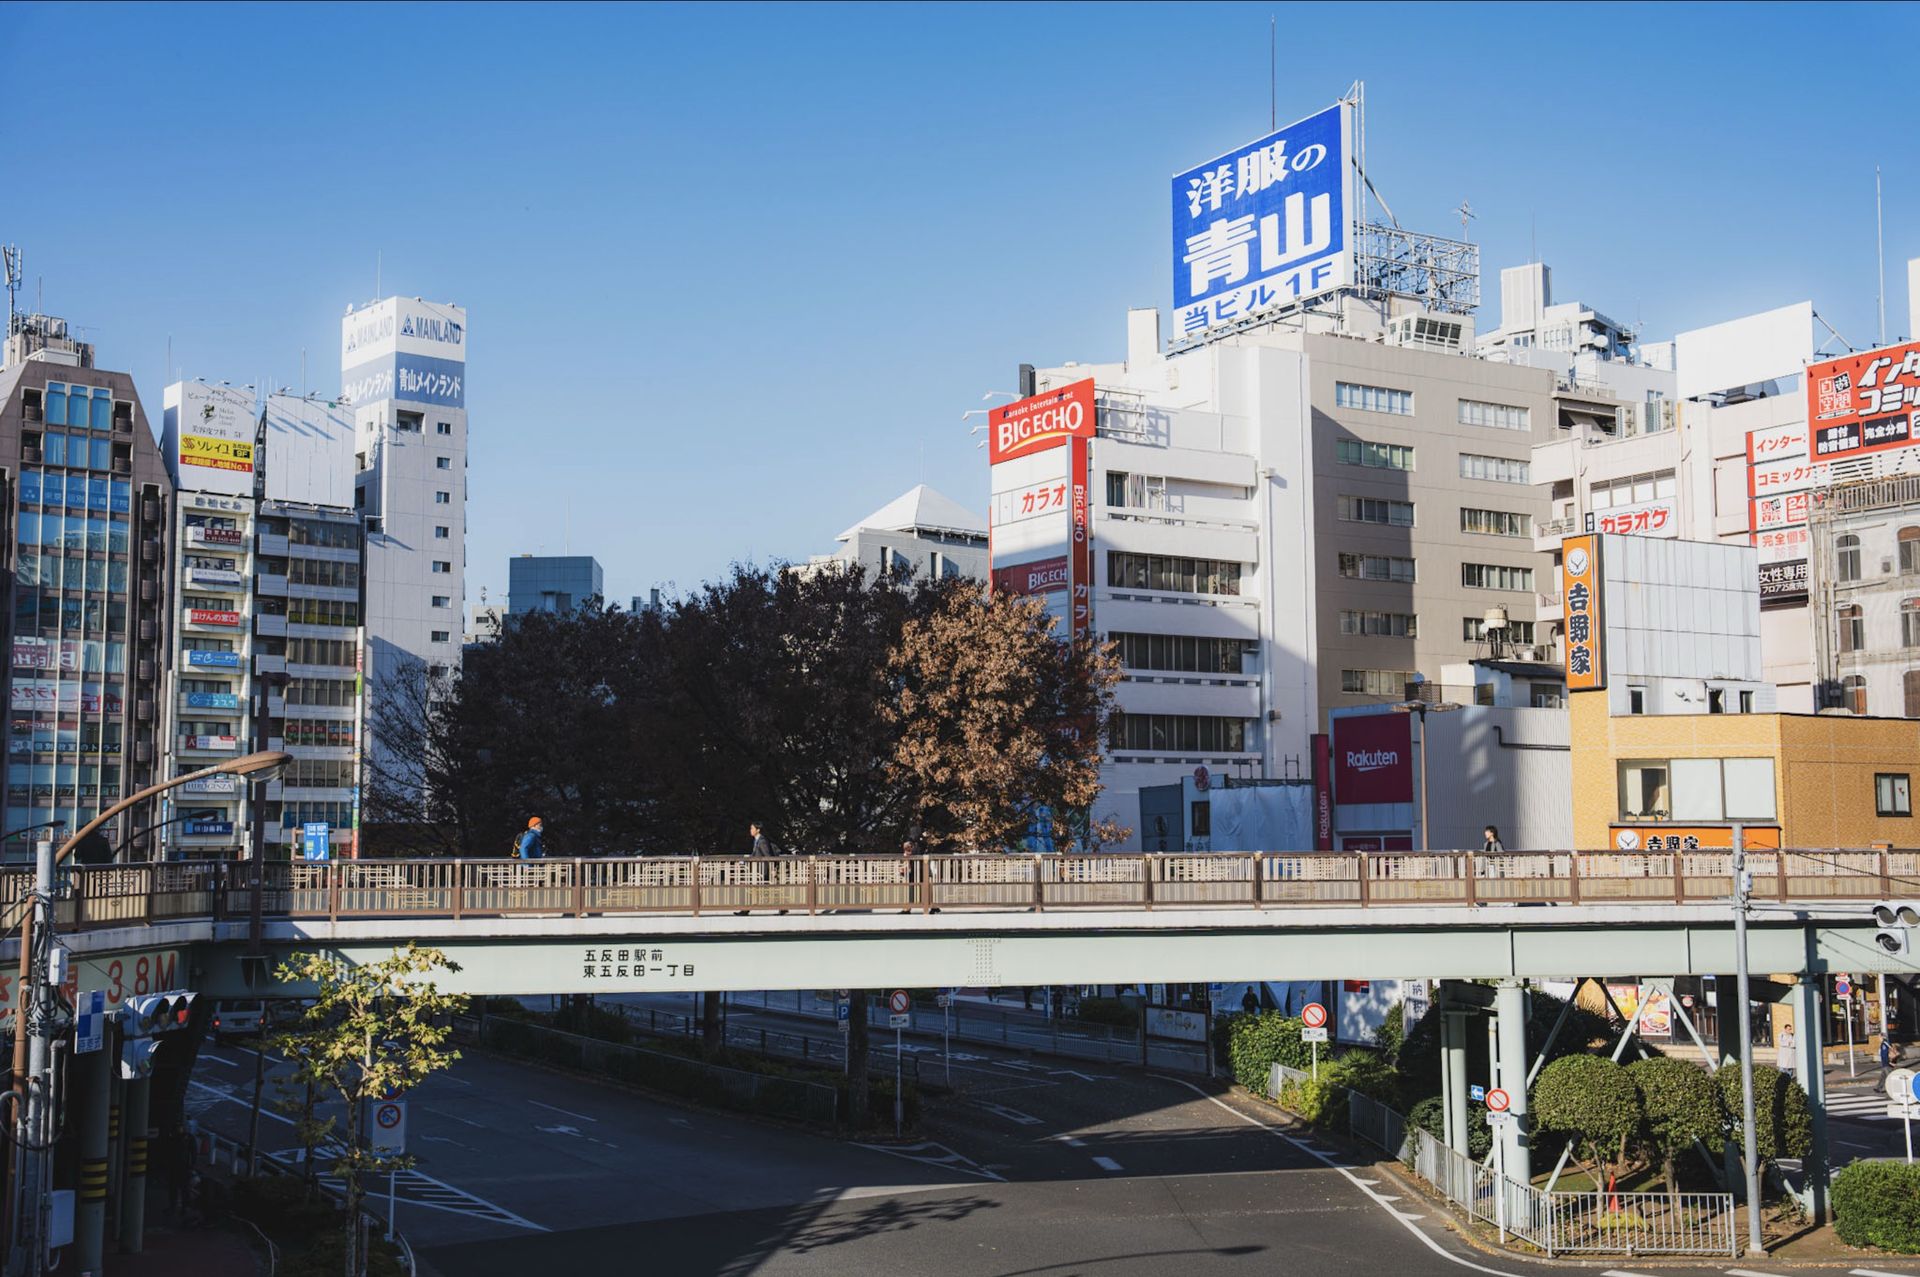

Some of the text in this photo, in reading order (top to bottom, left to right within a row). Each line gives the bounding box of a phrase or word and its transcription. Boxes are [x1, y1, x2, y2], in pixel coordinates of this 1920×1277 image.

[1186, 140, 1327, 219] 洋服の
[1183, 192, 1331, 297] 青山
[416, 317, 461, 344] MAINLAND
[399, 367, 461, 398] 青山メインランド
[998, 401, 1083, 452] BIG ECHO
[197, 441, 230, 454] ソレイユ
[1600, 508, 1670, 535] カラオケ
[1029, 571, 1048, 590] BIG
[1759, 563, 1808, 584] 女性専用
[1568, 582, 1591, 675] 吉野家
[1347, 750, 1398, 767] Rakuten
[1320, 791, 1328, 839] Rakuten
[1647, 835, 1699, 849] 吉野家
[584, 949, 663, 962] 五反田駅前
[583, 964, 695, 978] 東五反田一丁目
